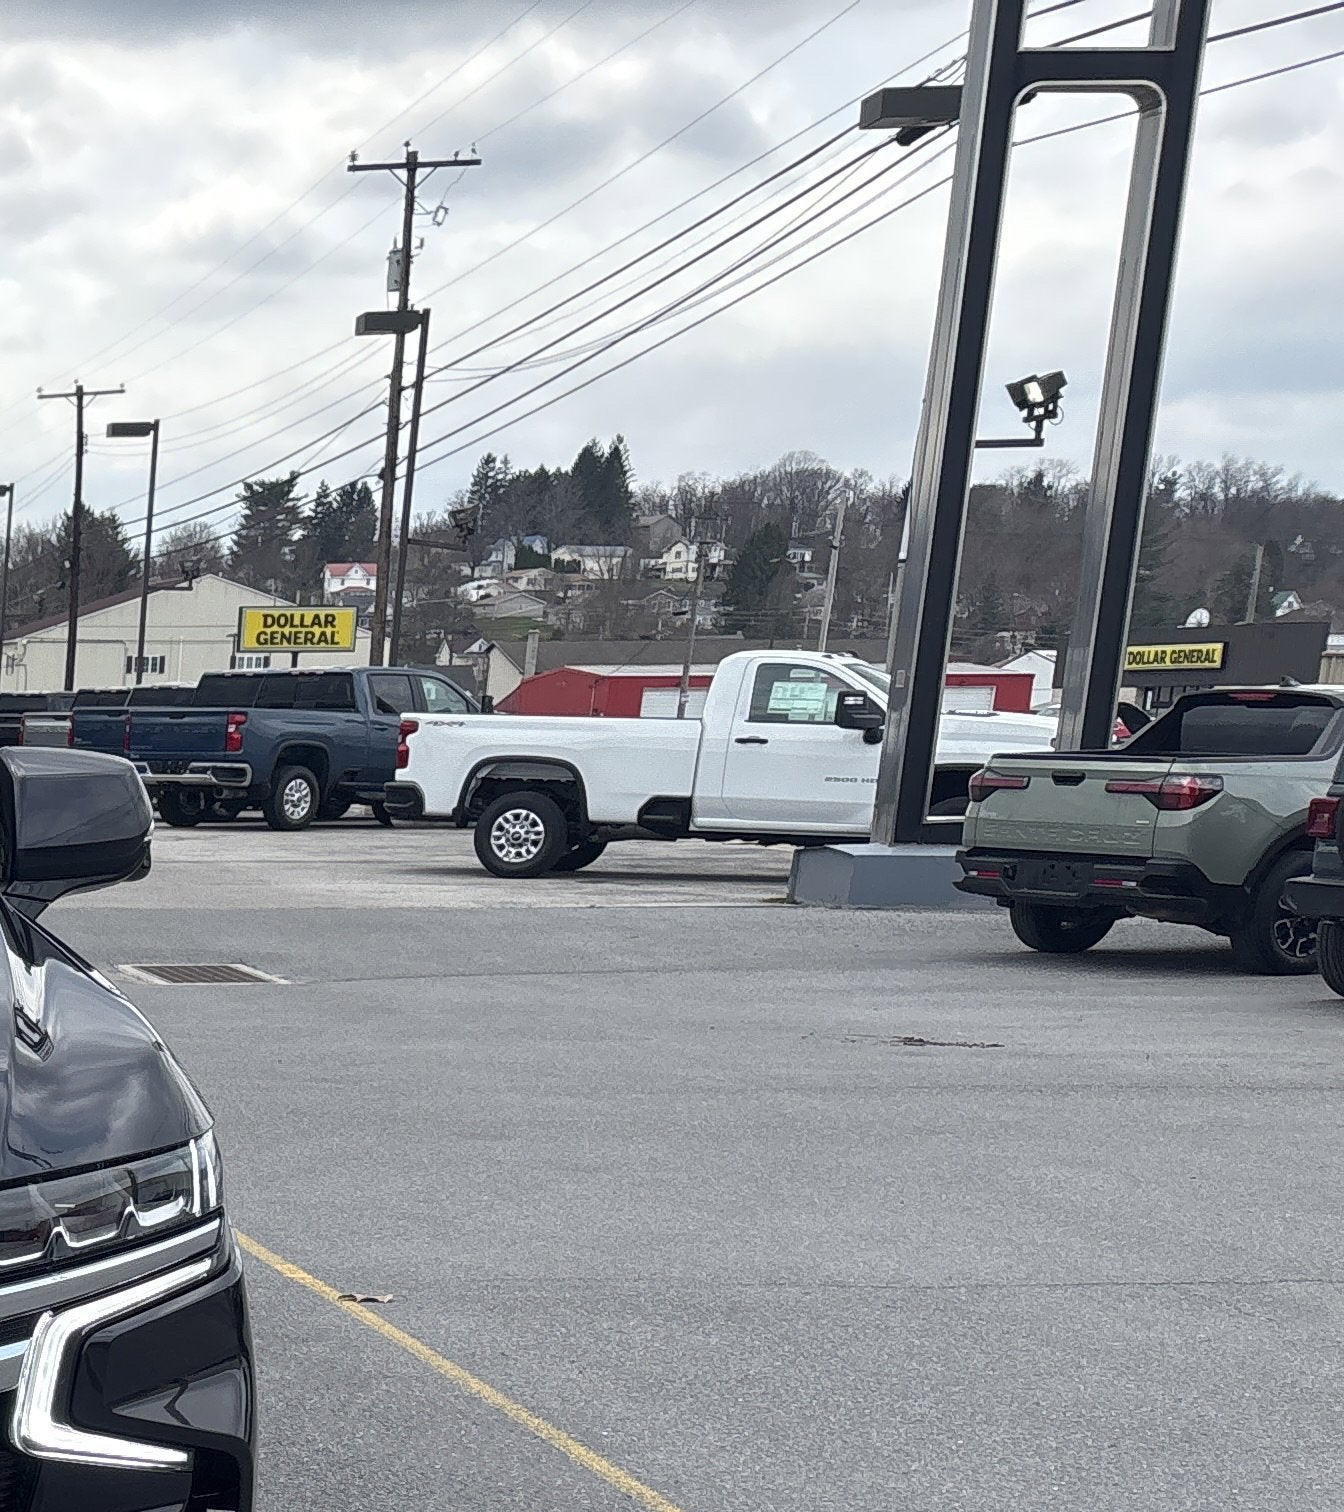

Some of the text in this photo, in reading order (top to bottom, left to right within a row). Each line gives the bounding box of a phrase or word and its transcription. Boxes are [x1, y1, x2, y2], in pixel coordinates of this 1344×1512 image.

[262, 613, 336, 628] DOLLAR
[255, 630, 340, 646] GENERAL
[1127, 648, 1217, 665] DOLLAR GENERAL
